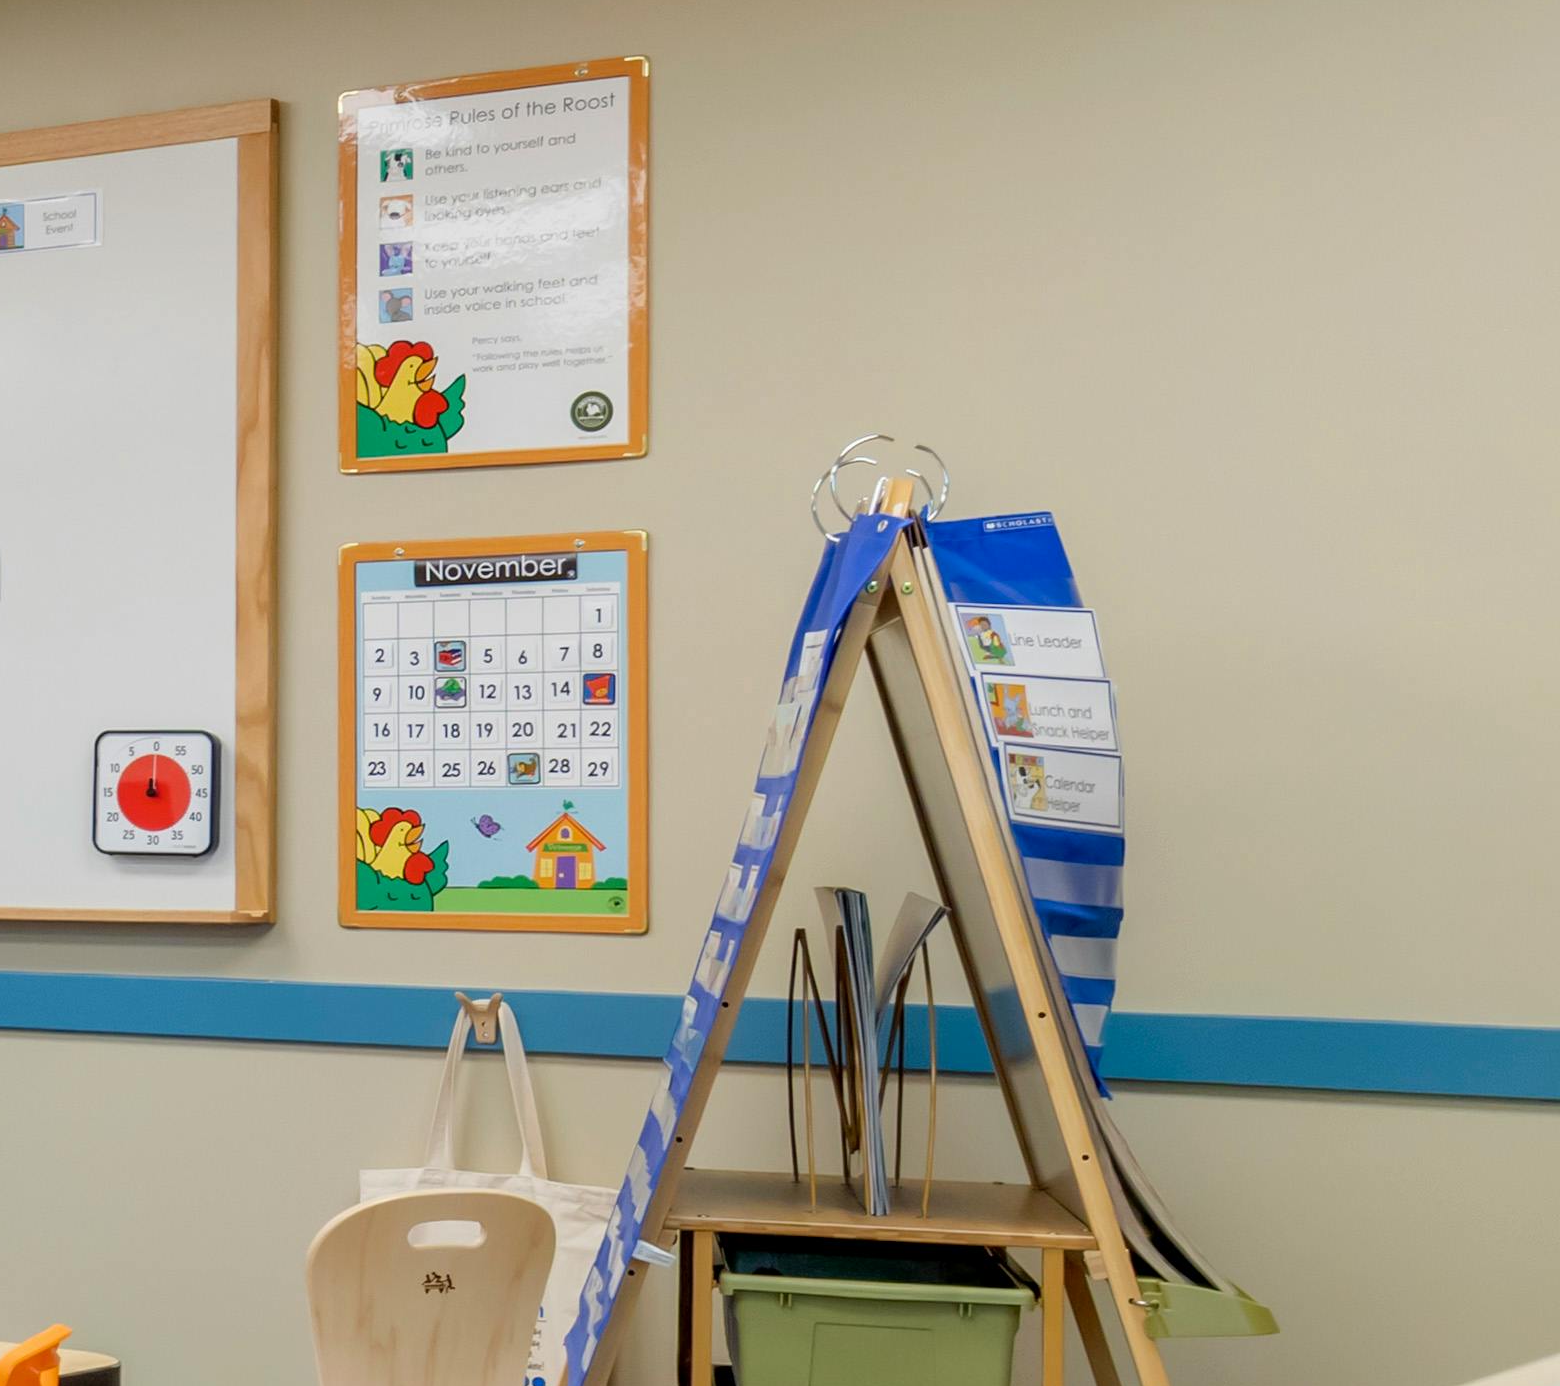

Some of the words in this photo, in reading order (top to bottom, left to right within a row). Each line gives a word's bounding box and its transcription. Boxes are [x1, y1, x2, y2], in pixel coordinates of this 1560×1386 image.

[449, 107, 495, 125] Rules
[501, 103, 521, 120] of
[526, 100, 556, 117] the
[563, 92, 616, 113] Roost
[424, 148, 442, 160] Be
[445, 142, 472, 158] kind
[476, 142, 490, 155] to
[494, 135, 544, 155] yourself
[548, 133, 577, 146] and
[424, 195, 448, 206] Use
[540, 183, 570, 194] ears
[42, 209, 77, 222] School
[45, 223, 74, 235] Event
[424, 287, 448, 300] Use
[450, 284, 479, 299] your
[482, 279, 534, 294] walking
[537, 276, 566, 289] feet
[569, 274, 598, 287] and
[424, 301, 461, 315] inside
[464, 297, 502, 311] voice
[505, 296, 517, 309] in
[522, 348, 539, 358] the
[496, 361, 518, 371] and
[425, 554, 568, 583] November
[594, 607, 602, 623] 1
[1010, 631, 1035, 648] Line
[1037, 633, 1083, 650] Leader
[374, 648, 385, 663] 2
[409, 650, 420, 666] 3
[482, 648, 493, 664] 5
[518, 649, 528, 665] 6
[559, 646, 570, 662] 7
[592, 643, 604, 659] 8
[372, 687, 382, 702] 9
[408, 685, 426, 701] 10
[479, 684, 497, 699] 12
[514, 684, 533, 700] 13
[551, 681, 571, 698] 14
[1030, 704, 1065, 718] Lunch
[1067, 706, 1093, 720] and
[373, 722, 391, 738] 16
[407, 723, 425, 739] 17
[442, 723, 461, 739] 18
[476, 723, 494, 739] 19
[511, 722, 534, 738] 20
[557, 723, 576, 739] 21
[589, 721, 612, 738] 22
[1033, 722, 1069, 738] Snack
[1071, 726, 1110, 742] Helper
[128, 746, 135, 757] 5
[153, 741, 160, 752] 0
[175, 745, 187, 756] 55
[110, 763, 120, 773] 10
[191, 764, 204, 775] 50
[367, 761, 386, 777] 23
[406, 762, 425, 778] 24
[442, 763, 461, 779] 25
[477, 761, 497, 776] 26
[548, 758, 571, 774] 28
[587, 761, 610, 778] 29
[1044, 774, 1096, 794] Calendar
[103, 787, 114, 798] 15
[195, 787, 208, 799] 45
[1047, 797, 1081, 814] Helper
[106, 812, 119, 822] 20
[189, 811, 202, 822] 40
[122, 829, 135, 840] 25
[146, 835, 160, 846] 30
[171, 830, 184, 841] 35
